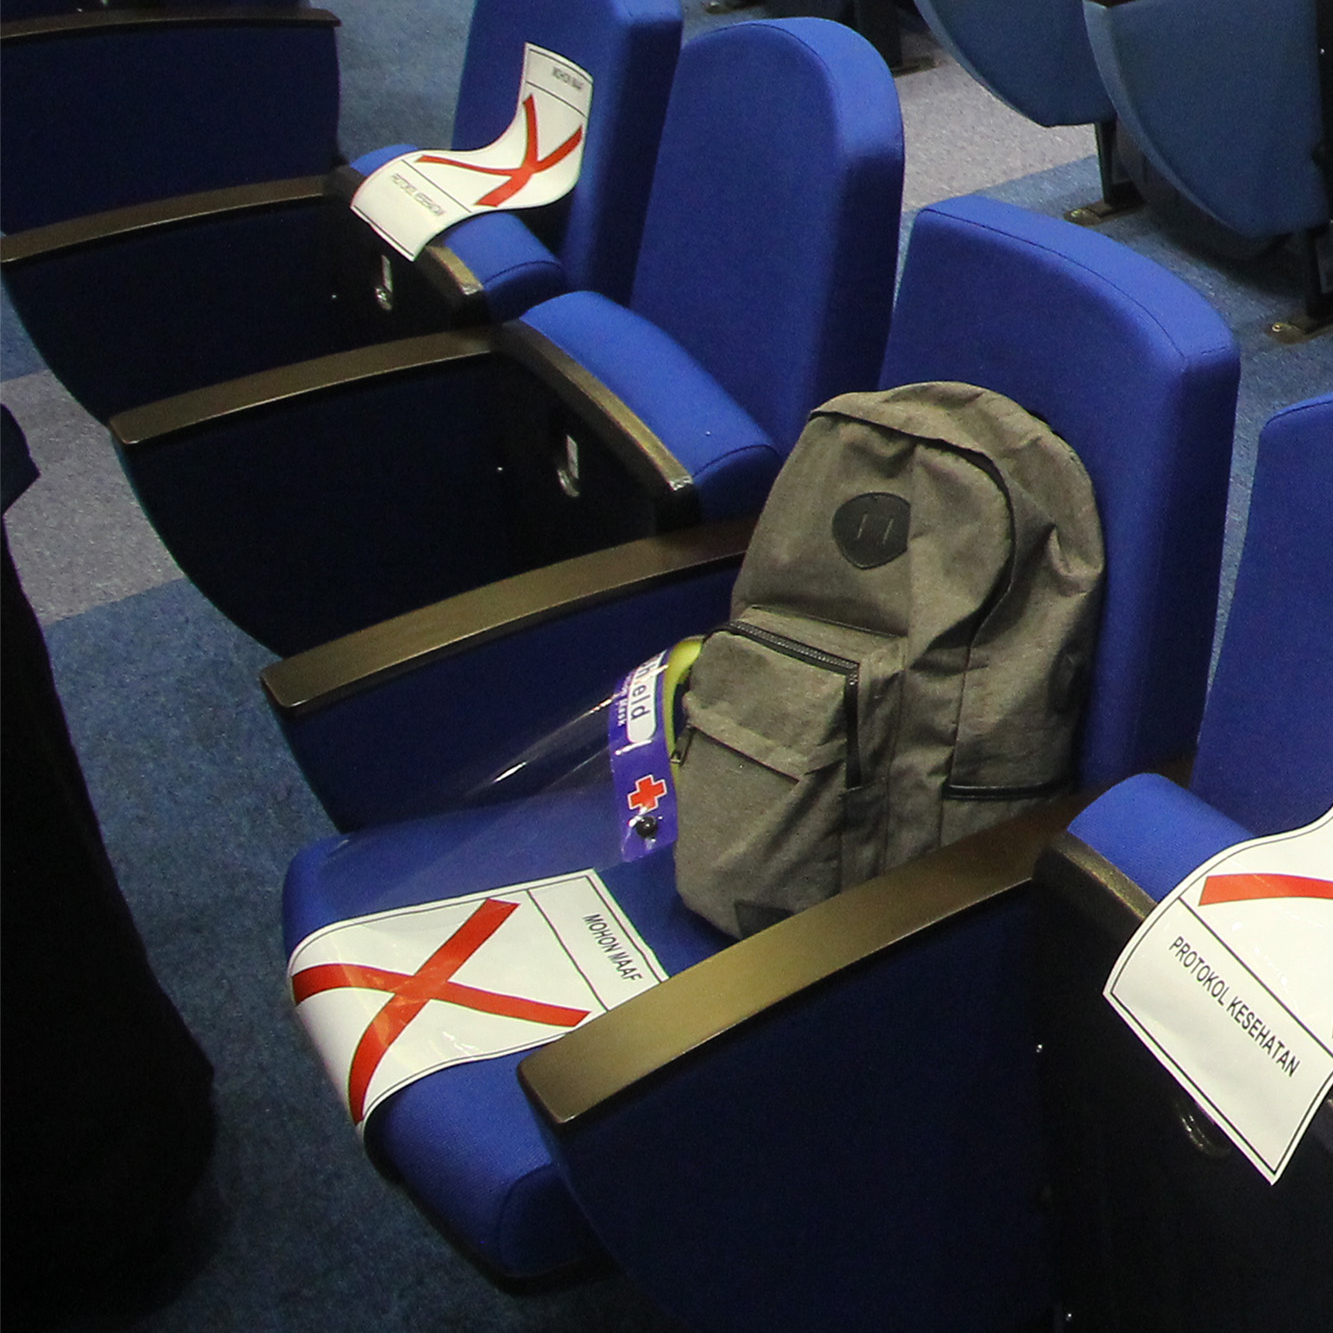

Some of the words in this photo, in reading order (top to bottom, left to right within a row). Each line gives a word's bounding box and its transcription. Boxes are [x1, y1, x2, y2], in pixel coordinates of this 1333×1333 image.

[582, 913, 622, 953] MOHON
[607, 951, 643, 981] MAAF
[1168, 935, 1230, 1007] PROTOKOL
[1226, 995, 1301, 1078] KESEHATAN
